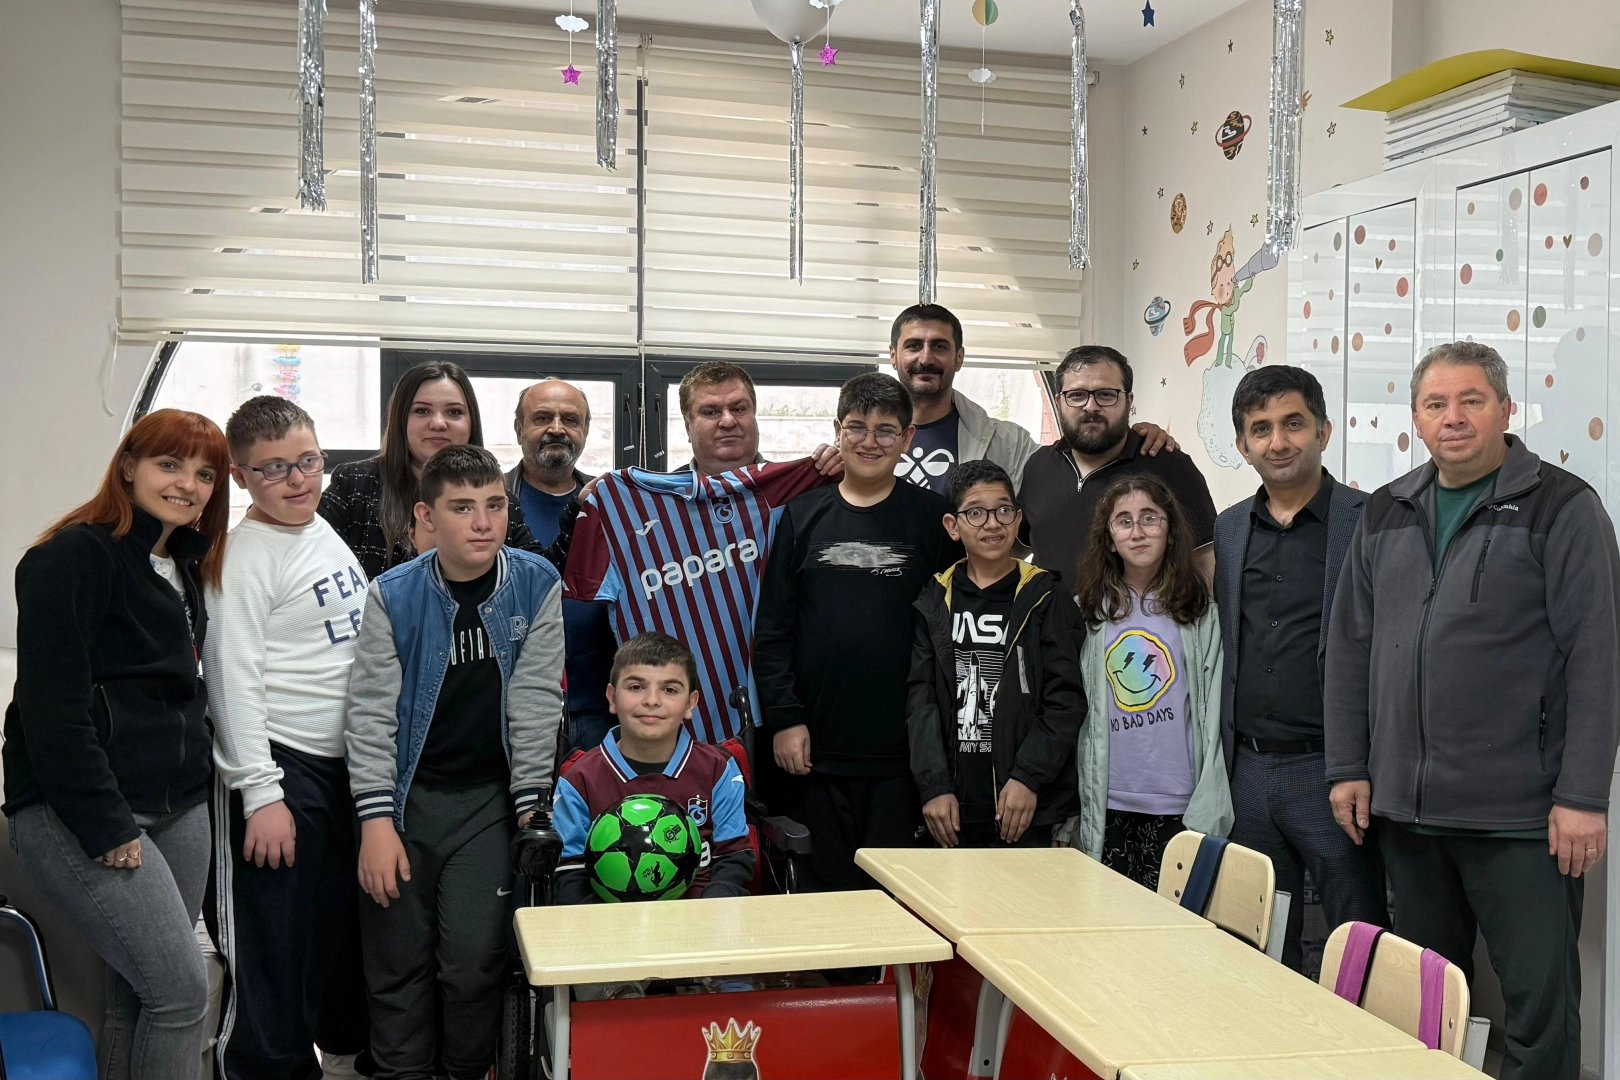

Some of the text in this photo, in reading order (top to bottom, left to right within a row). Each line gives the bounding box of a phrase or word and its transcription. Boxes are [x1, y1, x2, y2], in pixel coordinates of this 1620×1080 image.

[313, 563, 368, 607] FEA
[641, 538, 759, 600] papara
[1122, 714, 1144, 730] BAD
[1147, 707, 1174, 725] DAYS
[959, 741, 978, 753] MY
